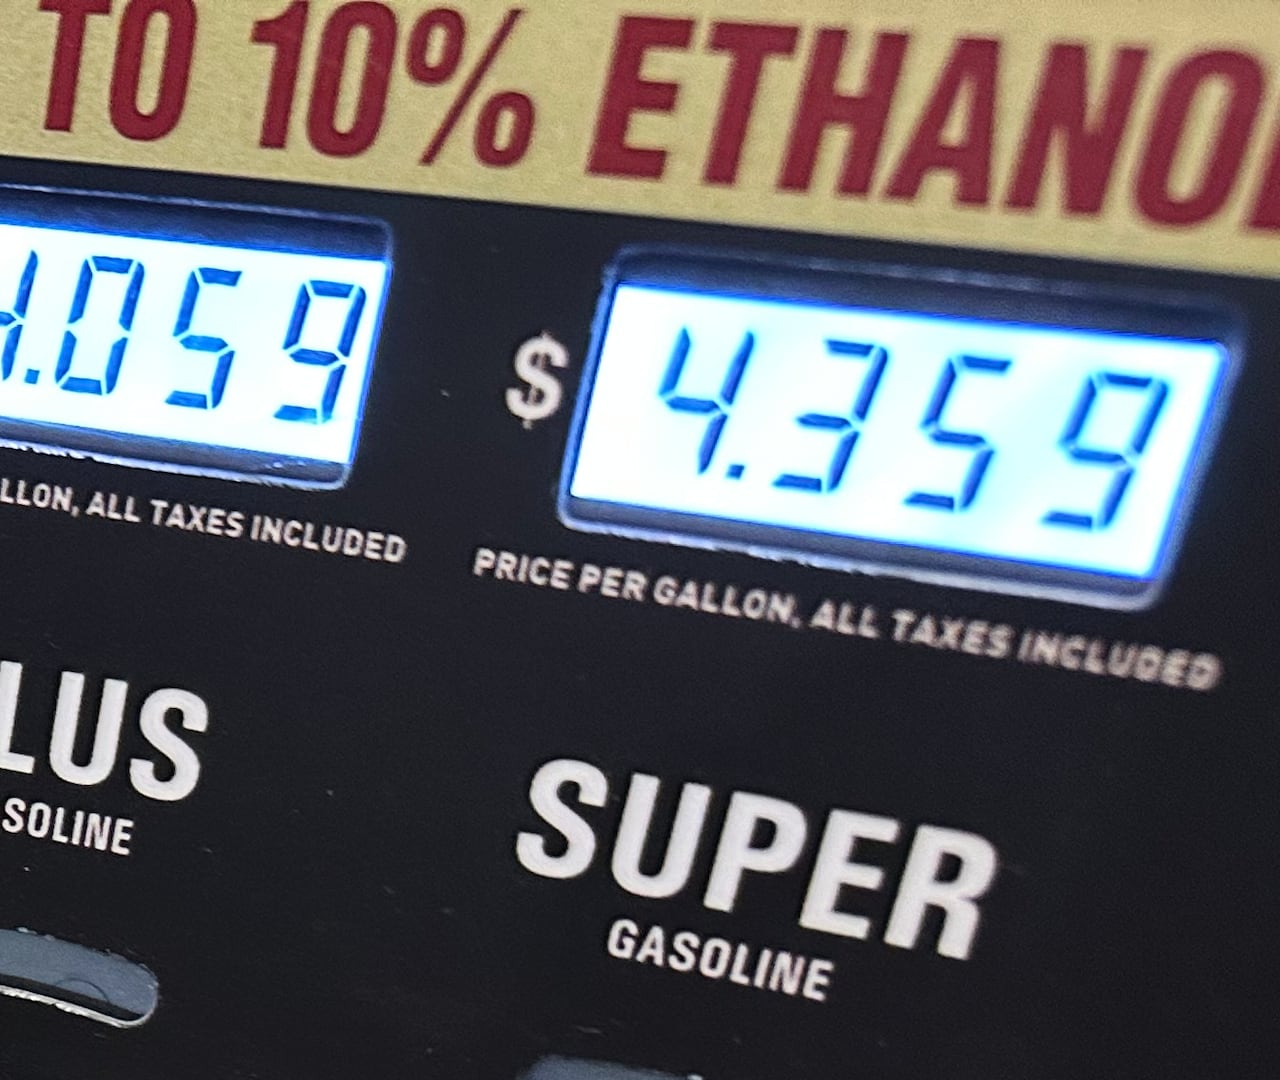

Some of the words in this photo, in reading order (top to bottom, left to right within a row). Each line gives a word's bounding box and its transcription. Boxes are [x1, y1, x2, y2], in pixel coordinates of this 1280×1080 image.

[40, 0, 198, 142] TO
[250, 0, 536, 168] 10%
[586, 15, 1280, 233] ETHANO
[505, 331, 570, 430] $
[656, 326, 1172, 534] 4.359
[85, 490, 142, 525] ALL
[150, 498, 245, 539] TAXES
[250, 515, 408, 565] INCLUDED
[472, 546, 575, 591] PRICE
[577, 563, 648, 603] PER
[808, 598, 880, 640] ALL
[890, 608, 1015, 659] TAXES
[1016, 628, 1224, 692] INCLUDED
[515, 757, 999, 961] SUPER
[606, 917, 836, 1002] GASOLINE
